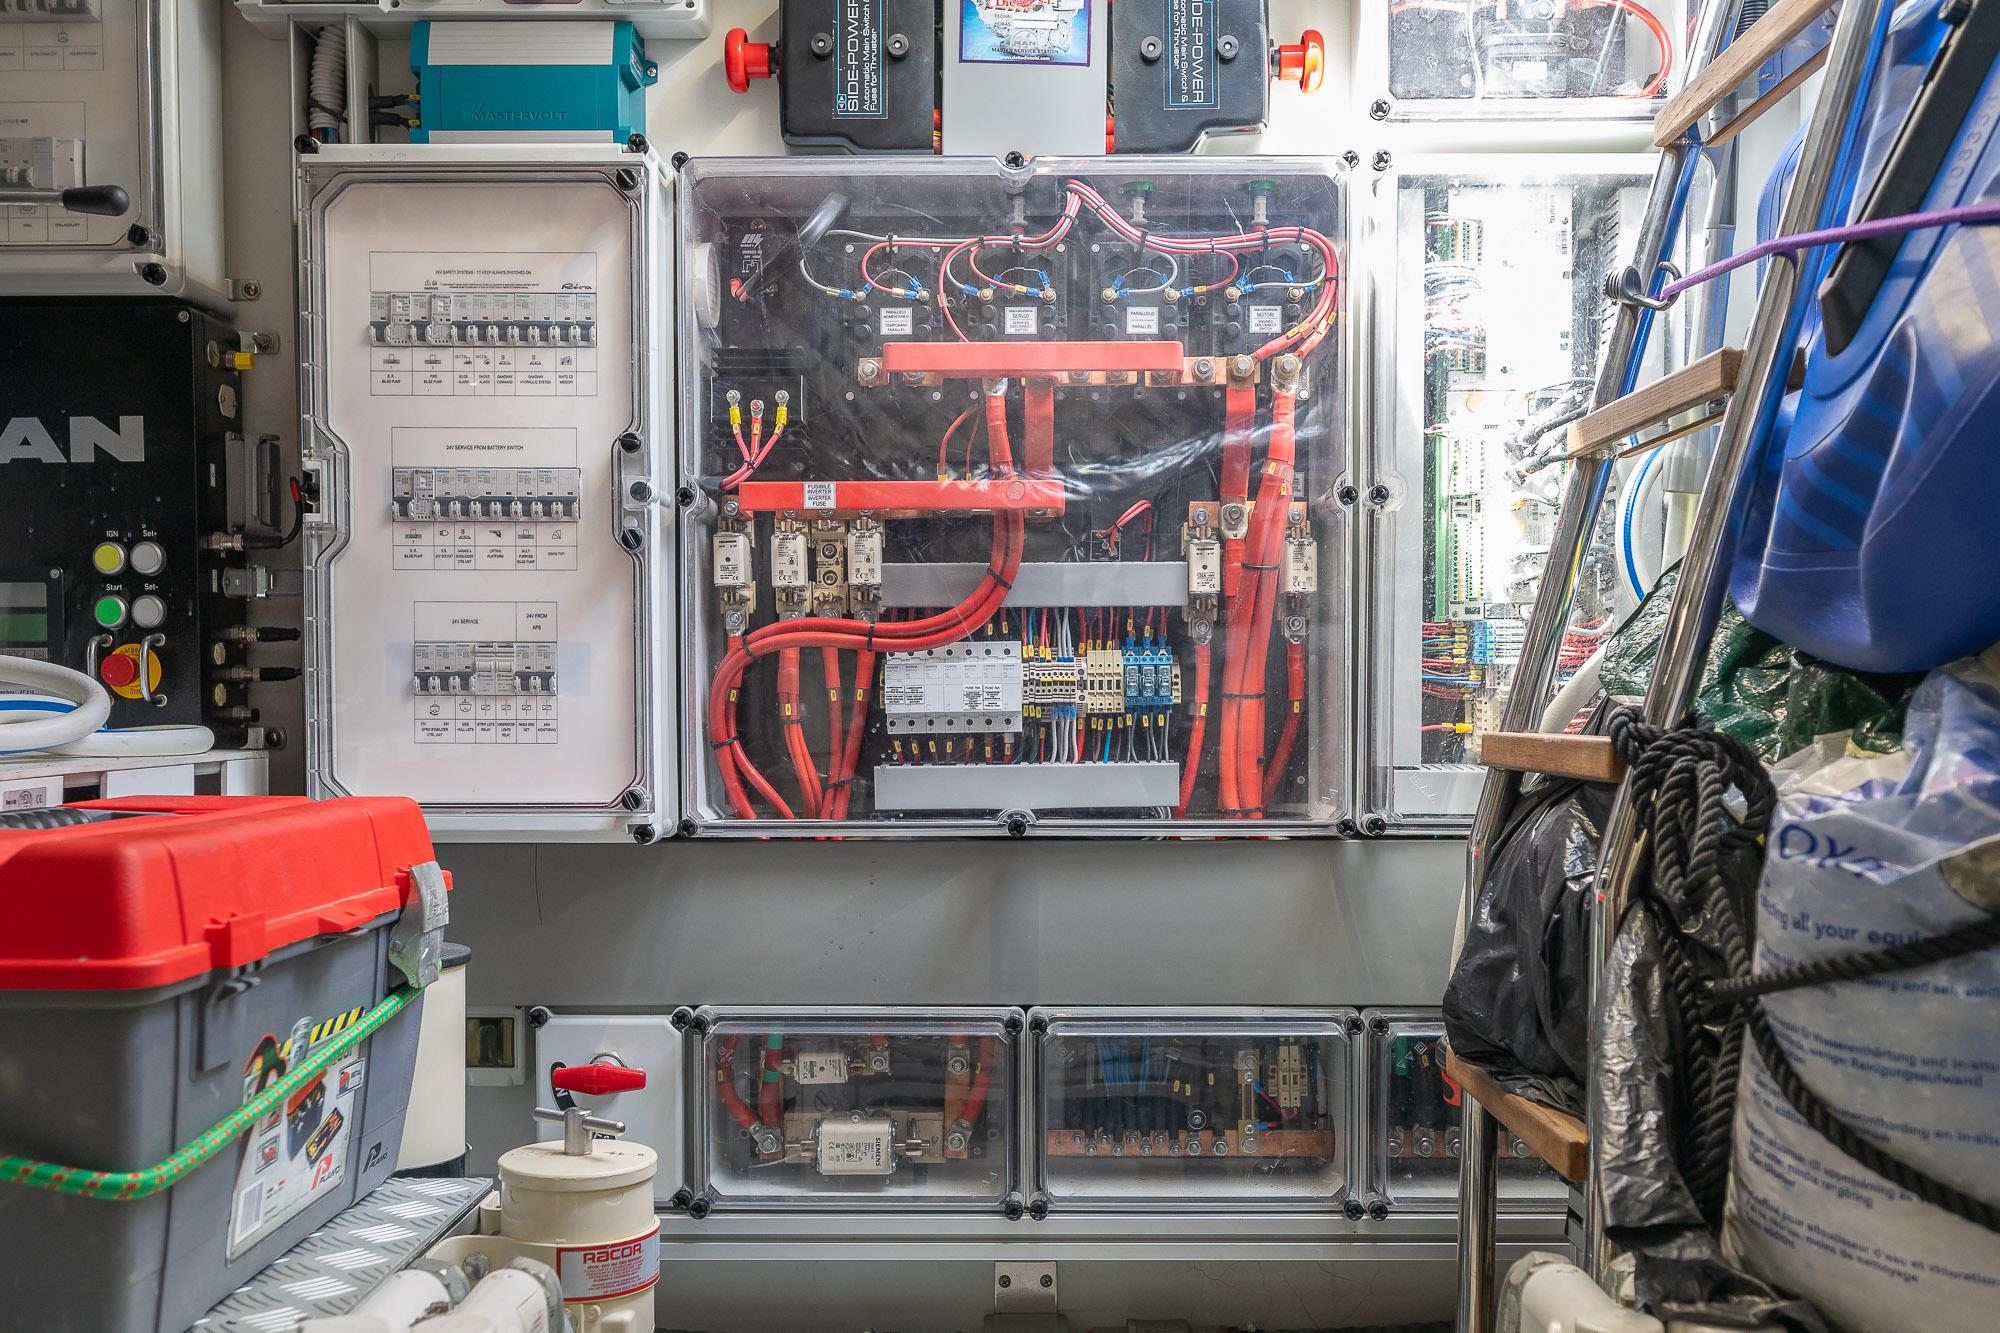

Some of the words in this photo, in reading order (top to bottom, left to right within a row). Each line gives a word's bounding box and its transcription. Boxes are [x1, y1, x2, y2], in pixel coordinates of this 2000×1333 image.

[1793, 912, 1810, 932] all
[1814, 922, 1860, 940] your
[1920, 1056, 1948, 1070] und
[319, 1164, 342, 1184] PLANO
